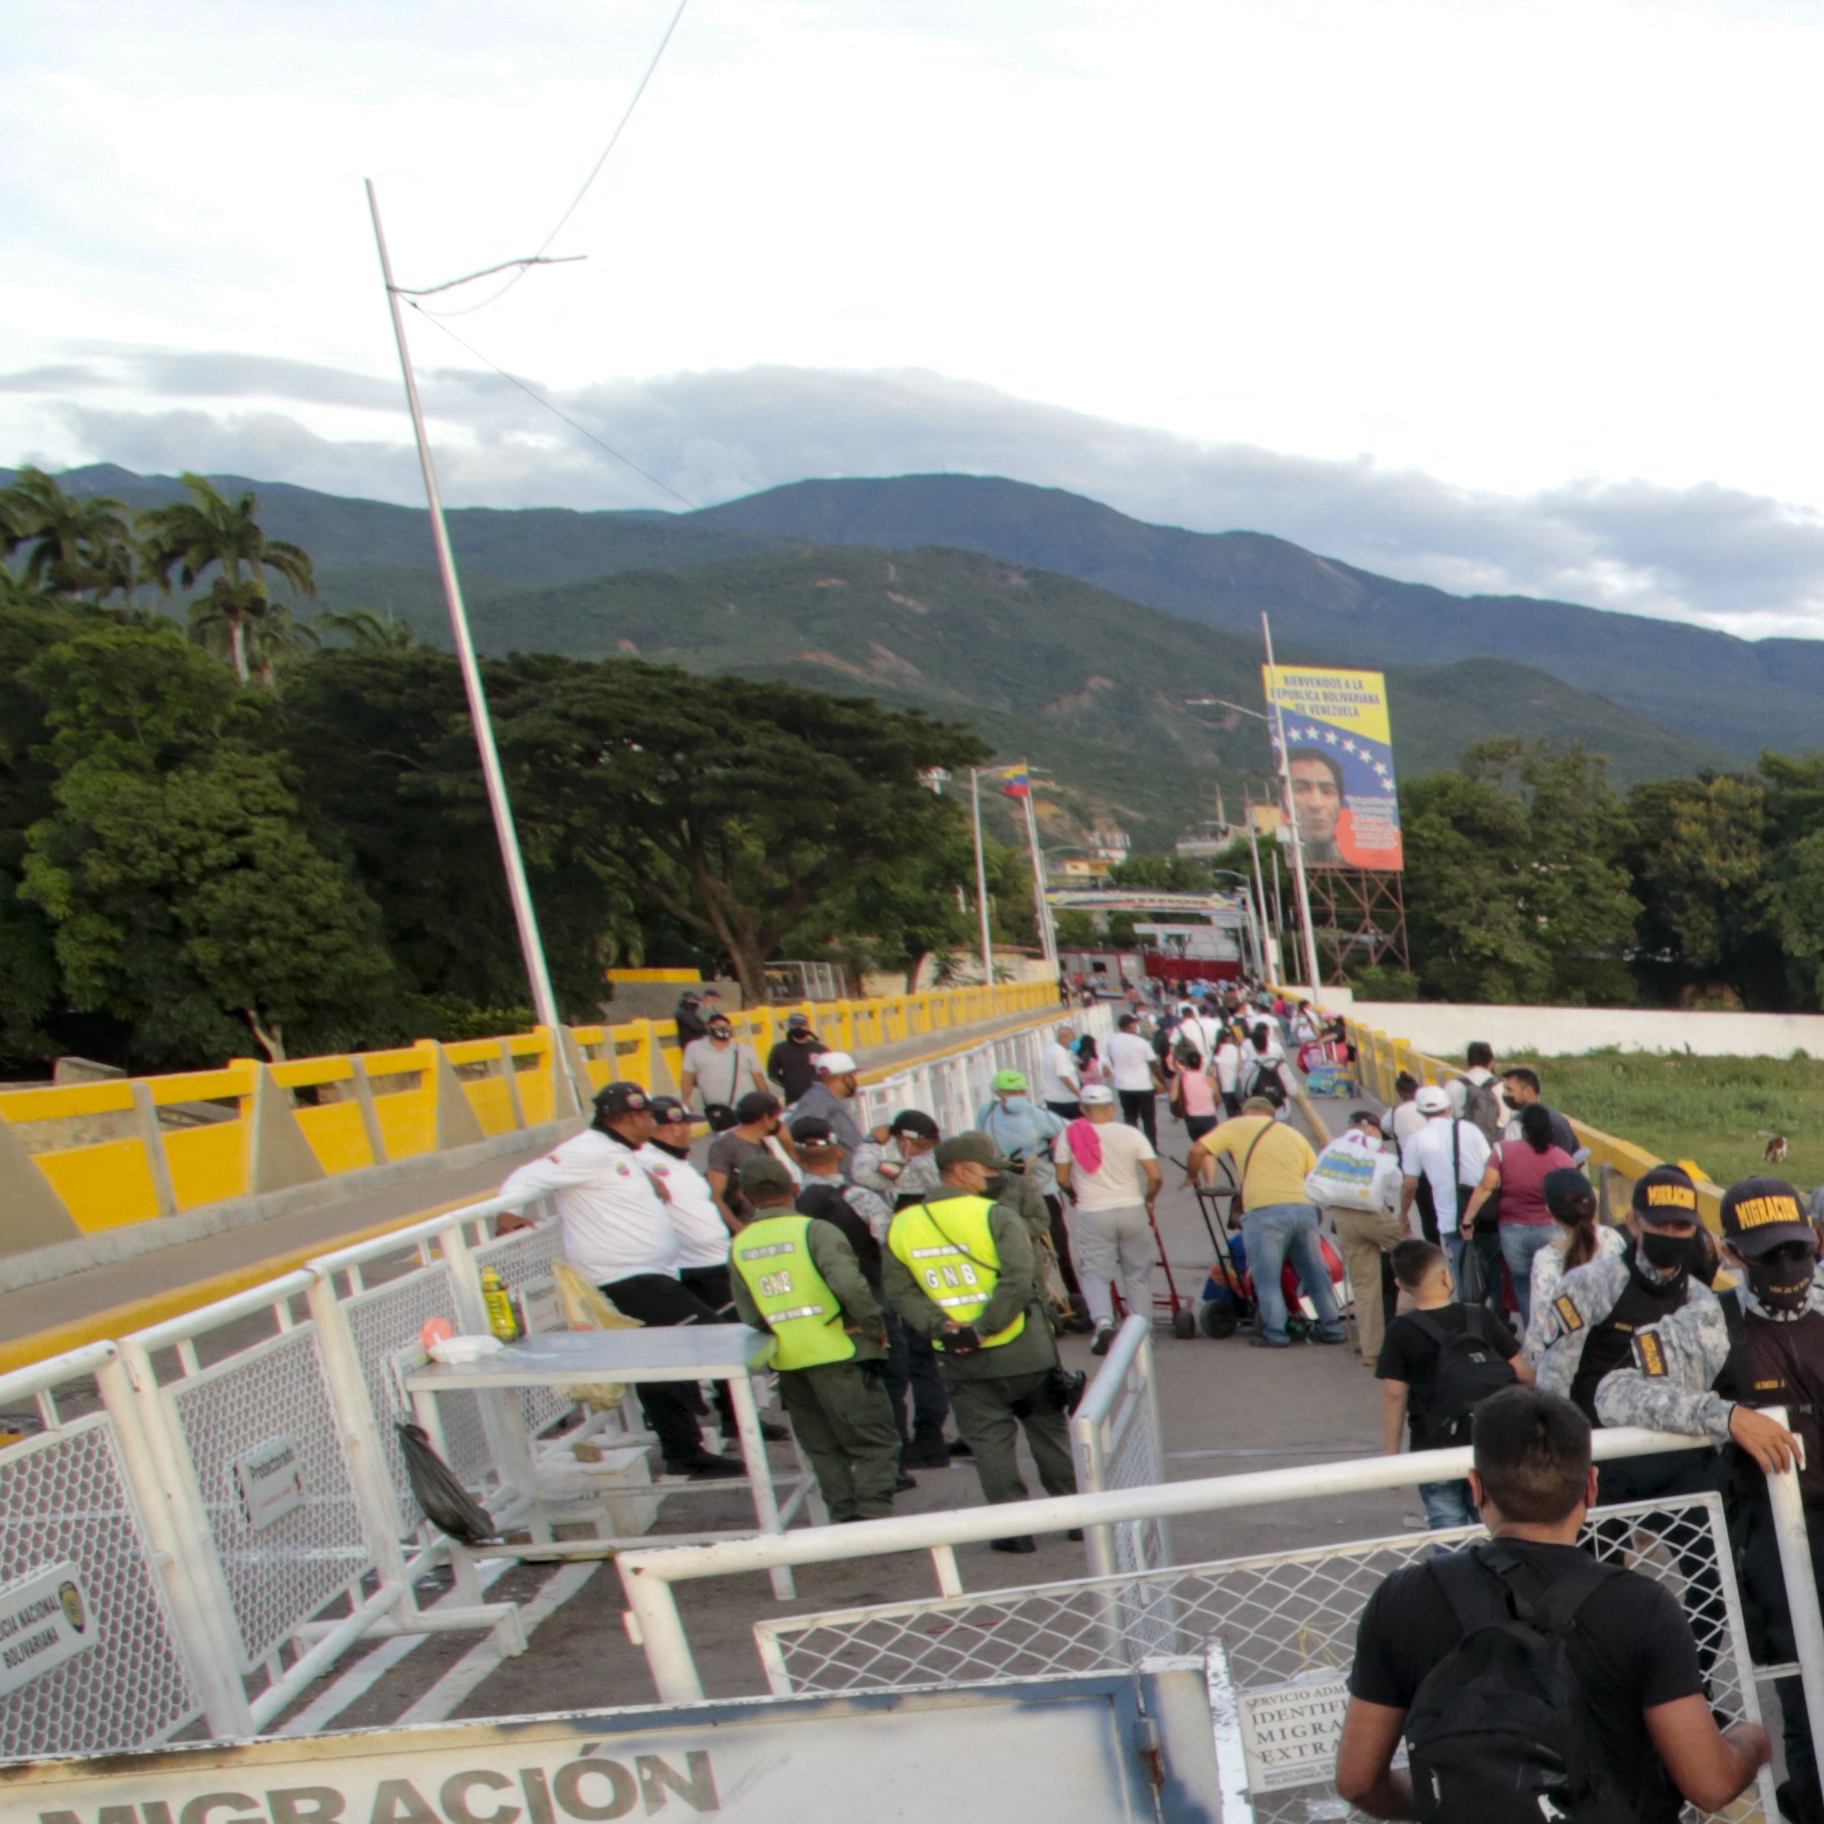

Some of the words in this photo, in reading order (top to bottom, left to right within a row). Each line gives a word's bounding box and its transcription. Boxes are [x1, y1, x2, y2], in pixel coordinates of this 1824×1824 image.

[1310, 704, 1360, 717] VENEZUELA
[1735, 1195, 1800, 1231] MIGRACION
[18, 1593, 61, 1629] NACIONAL
[2, 1626, 61, 1670] BOLIVARIANA
[1245, 1690, 1310, 1710] SERVICIO
